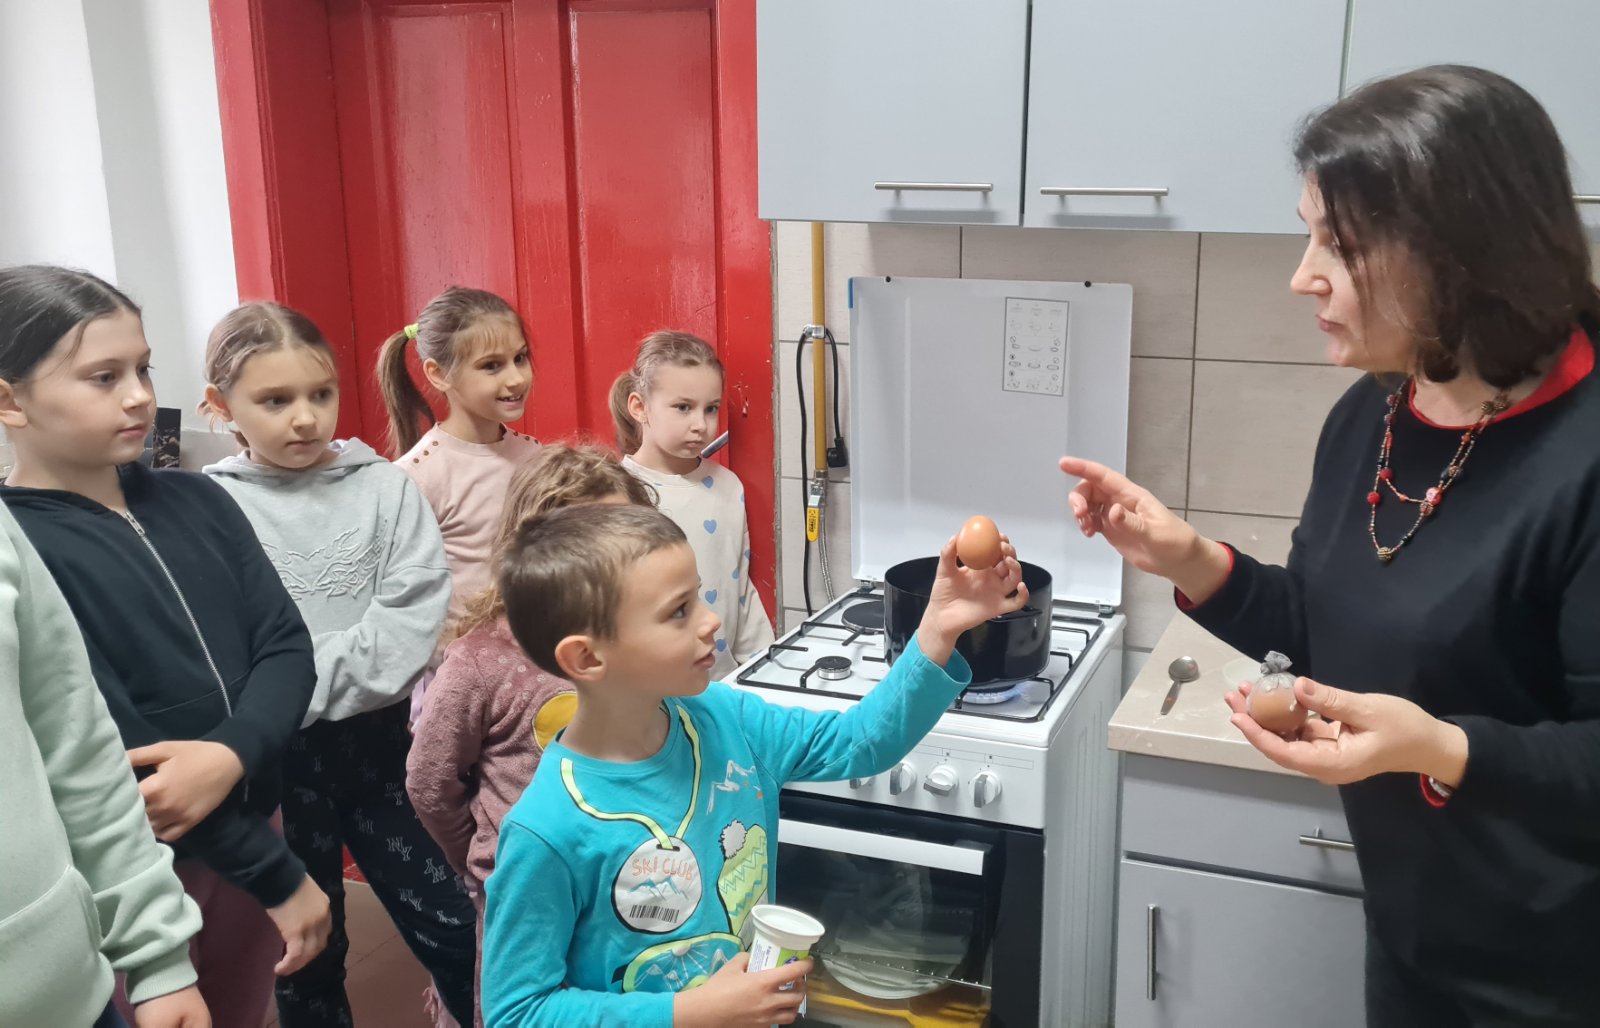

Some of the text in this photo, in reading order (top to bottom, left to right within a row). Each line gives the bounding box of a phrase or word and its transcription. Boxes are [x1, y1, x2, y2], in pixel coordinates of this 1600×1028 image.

[386, 837, 412, 861] NY
[632, 856, 693, 880] SKI CLUB
